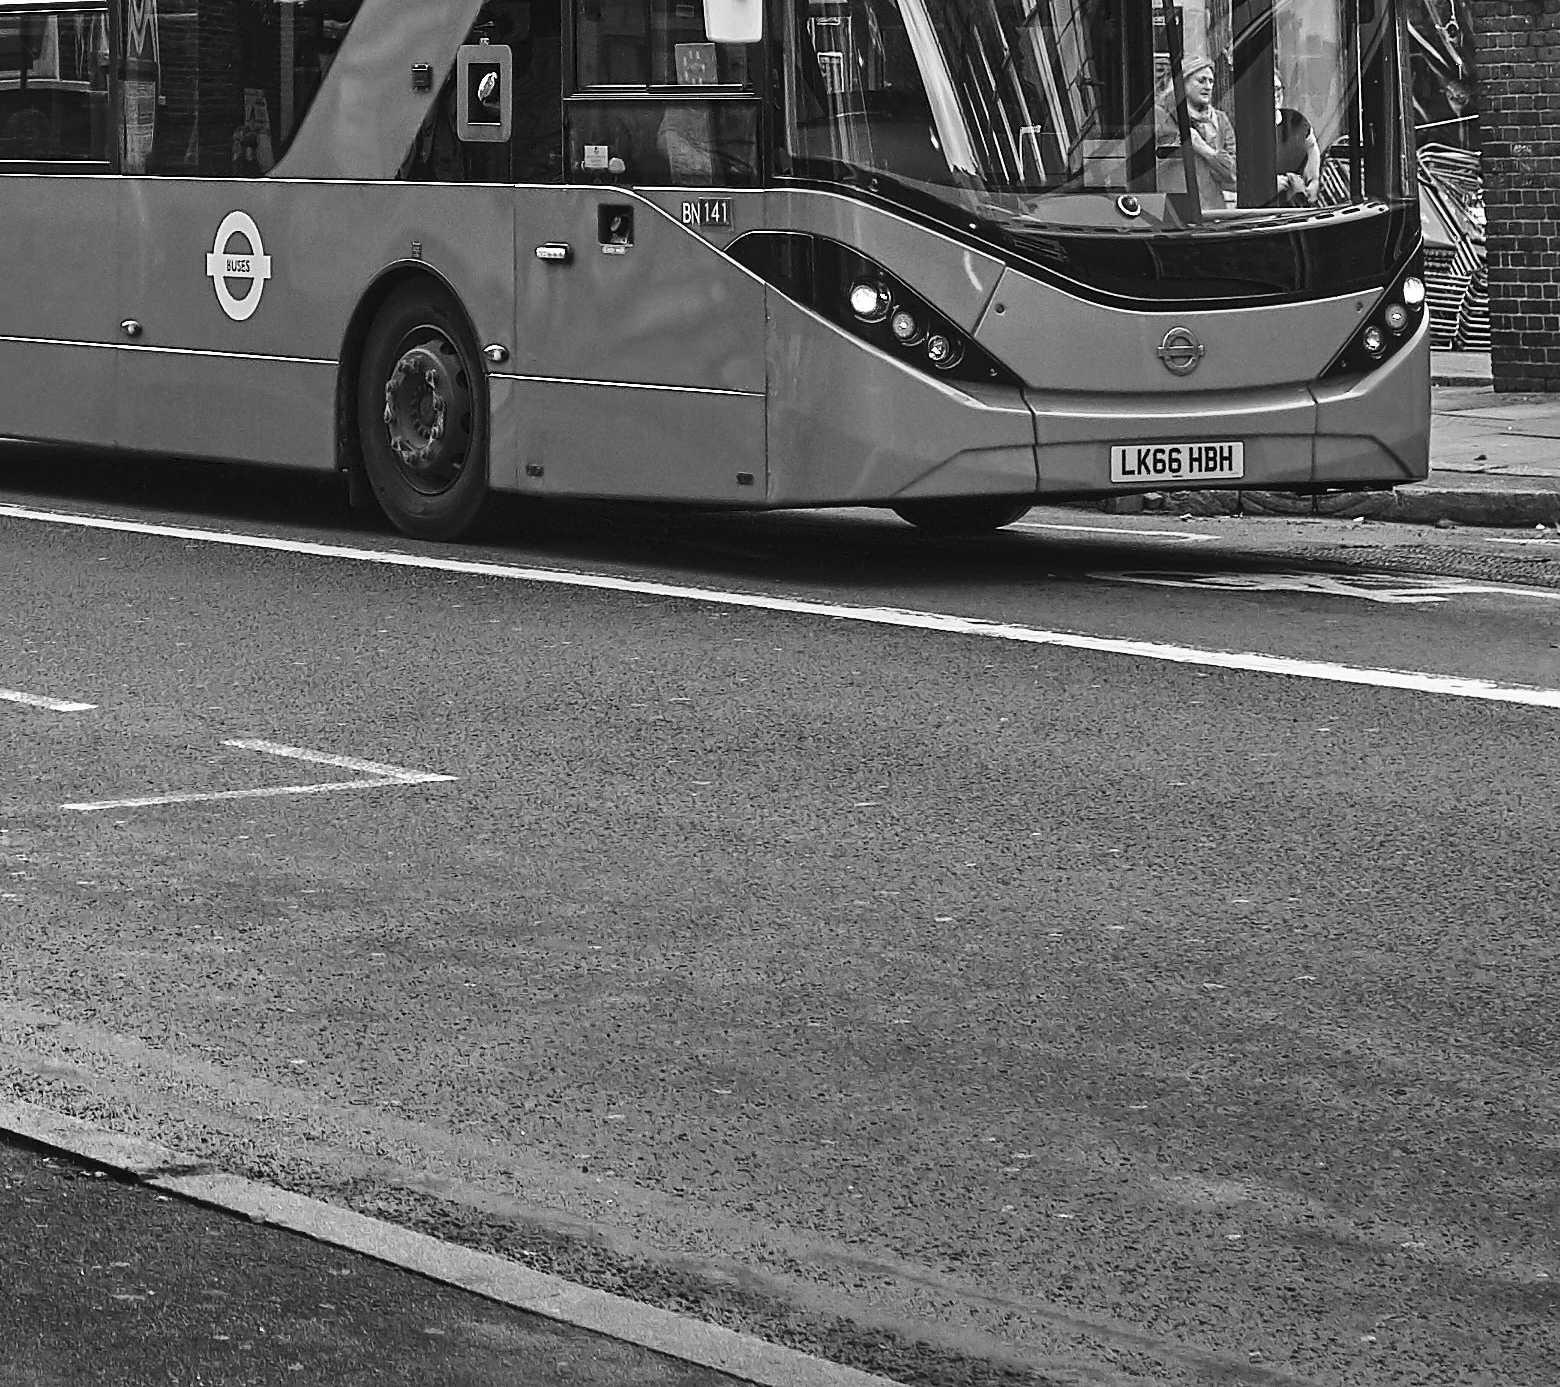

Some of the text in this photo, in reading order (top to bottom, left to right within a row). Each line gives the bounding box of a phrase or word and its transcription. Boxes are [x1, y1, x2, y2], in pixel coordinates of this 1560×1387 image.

[682, 201, 728, 224] BN 141
[226, 259, 251, 273] BUSES
[1120, 444, 1234, 476] LK66 HBH
